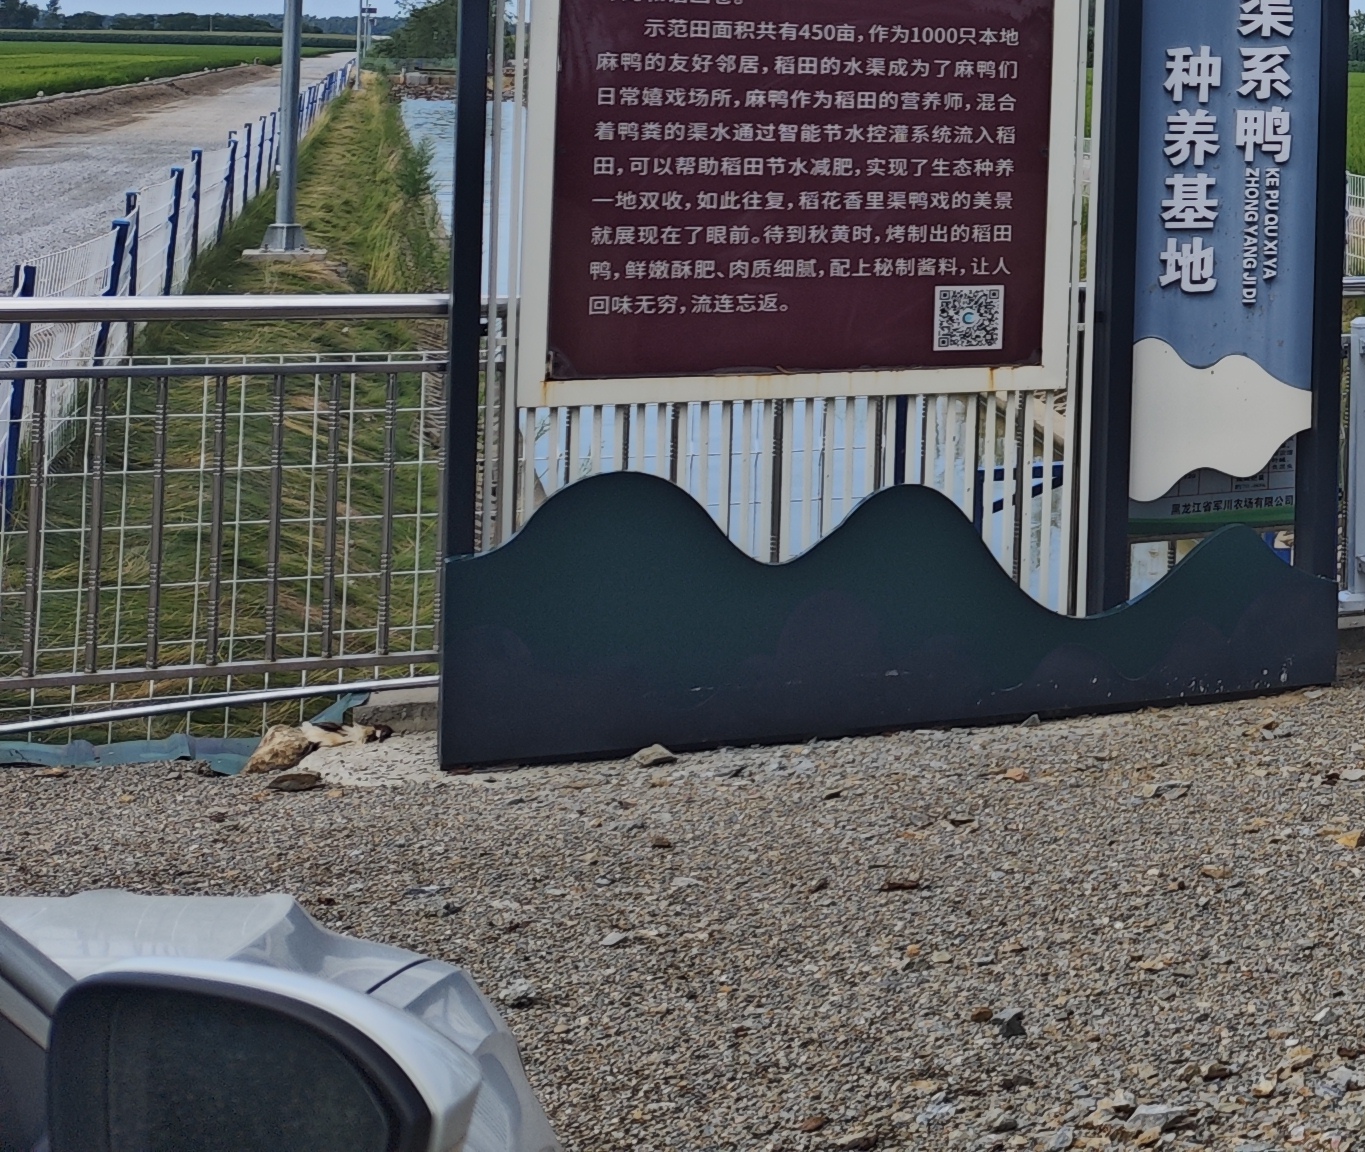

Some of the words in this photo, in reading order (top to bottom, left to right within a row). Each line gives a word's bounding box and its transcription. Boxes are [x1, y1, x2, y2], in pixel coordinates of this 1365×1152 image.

[595, 52, 1018, 79] 麻鸭的友好邻居，稻田的水渠成为了麻鸭们
[594, 121, 1016, 145] 着鸭粪的渠水通过智能节水控灌系统流入稻
[1159, 45, 1222, 294] 种养基地
[1265, 168, 1280, 187] KE
[1243, 167, 1260, 222] ZHONG
[1264, 190, 1280, 210] PU
[1263, 213, 1279, 237] QU
[1242, 224, 1259, 269] YANG
[1263, 239, 1278, 255] XI
[1242, 271, 1257, 285] JI
[1262, 257, 1278, 279] YA
[588, 293, 789, 316] 回味无穷，流连忘返。
[1241, 287, 1257, 303] DI
[1170, 494, 1295, 516] 黑龙江省军川农场有限公司
